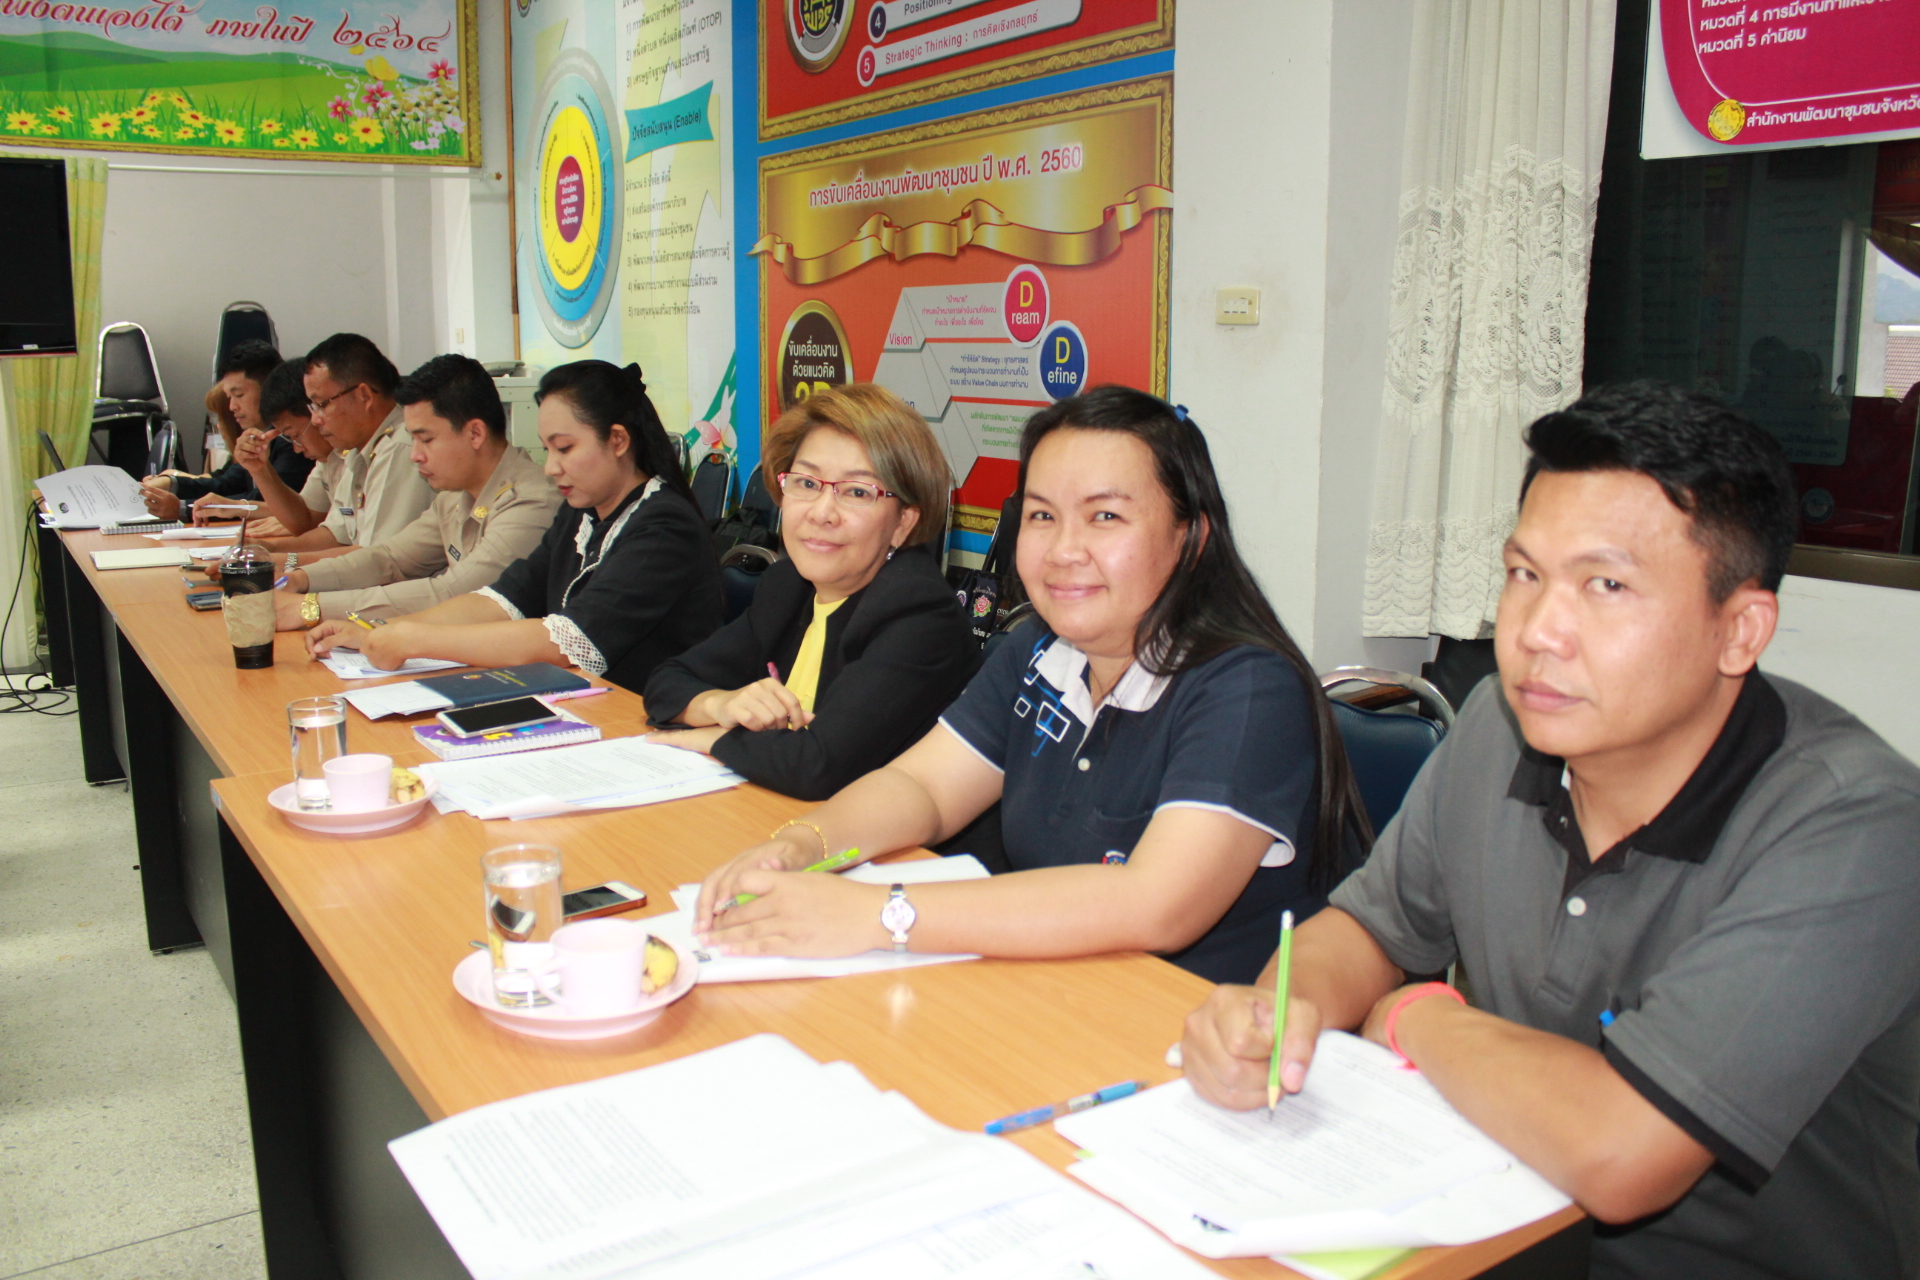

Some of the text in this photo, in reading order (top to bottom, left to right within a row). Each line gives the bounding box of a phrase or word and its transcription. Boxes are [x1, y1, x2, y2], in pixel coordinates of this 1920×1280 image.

[875, 13, 881, 28] 4
[1700, 4, 1746, 31] หมวดที่
[1749, 9, 1759, 23] 4
[864, 58, 870, 73] 5
[885, 43, 923, 65] Strategic
[925, 32, 962, 49] Thinking
[1699, 27, 1807, 54] หมวดที่ 5 ค่านิยม
[674, 108, 702, 132] (Enable)
[1746, 94, 1920, 127] สำนักงานพัฒนาชุมชนจังหวั
[809, 145, 1081, 207] การขับเคลื่อนงานพัฒนาชุมชน ปี พ.ศ. 2560
[1020, 281, 1034, 307] D
[1011, 312, 1040, 325] ream
[788, 335, 838, 357] ขับเคลื่อนงาน
[889, 333, 913, 345] Vision
[1055, 337, 1070, 364] D
[792, 360, 835, 378] ด้วยแนวคิด
[1047, 367, 1077, 386] efine
